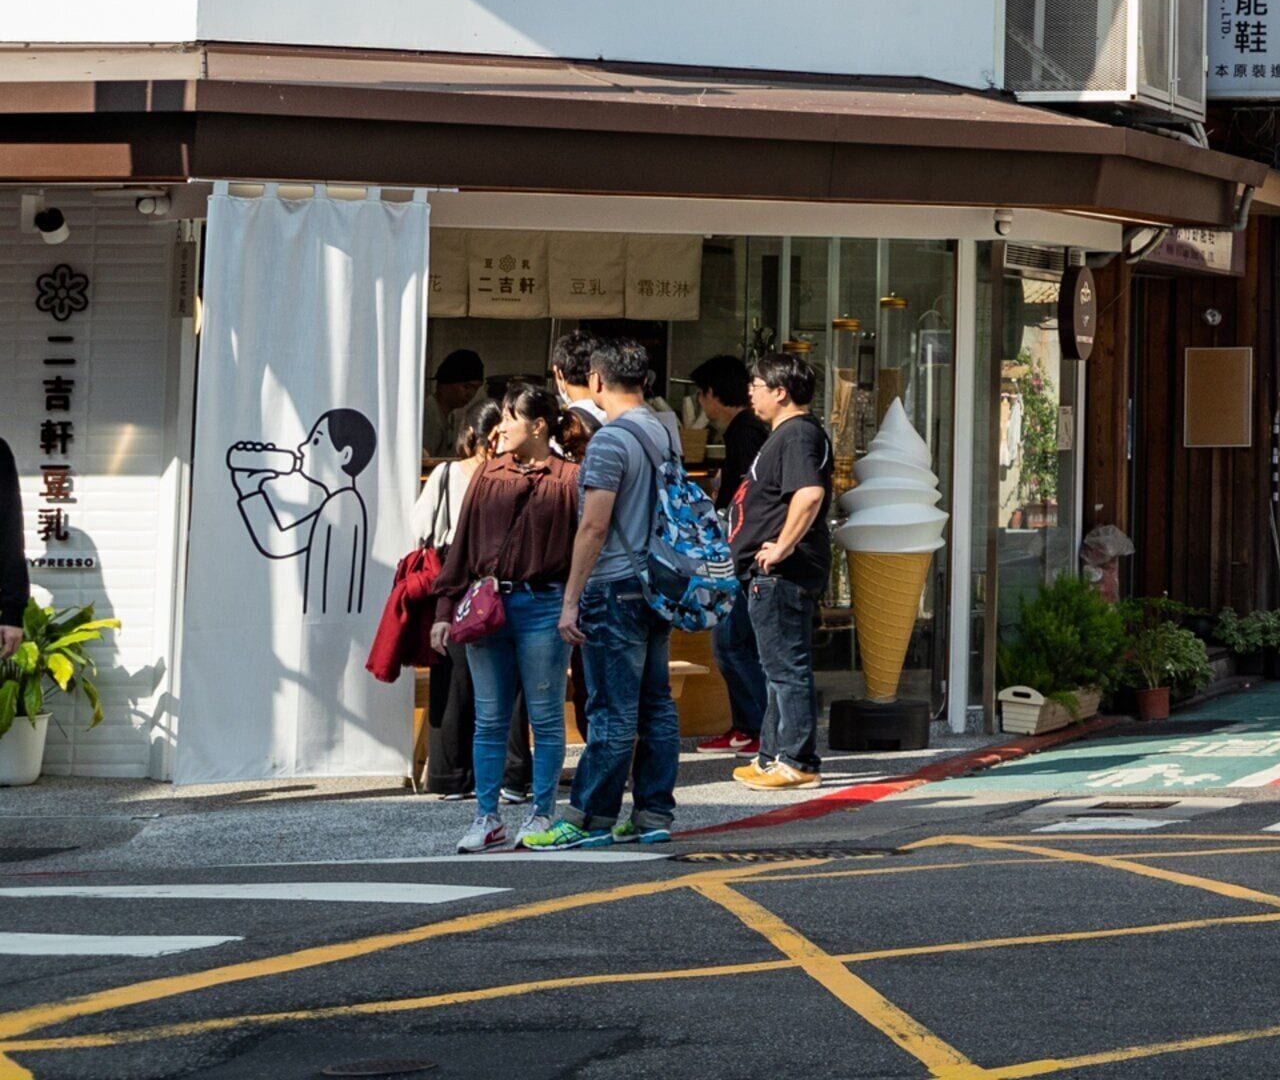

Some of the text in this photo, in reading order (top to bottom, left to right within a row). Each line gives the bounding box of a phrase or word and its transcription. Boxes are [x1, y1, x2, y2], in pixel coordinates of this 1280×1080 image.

[478, 276, 536, 294] 二吉軒
[570, 277, 607, 296] 豆乳
[637, 279, 692, 298] 霜淇淋
[38, 335, 76, 542] 二吉軒豆乳
[27, 558, 94, 568] YPRESSO
